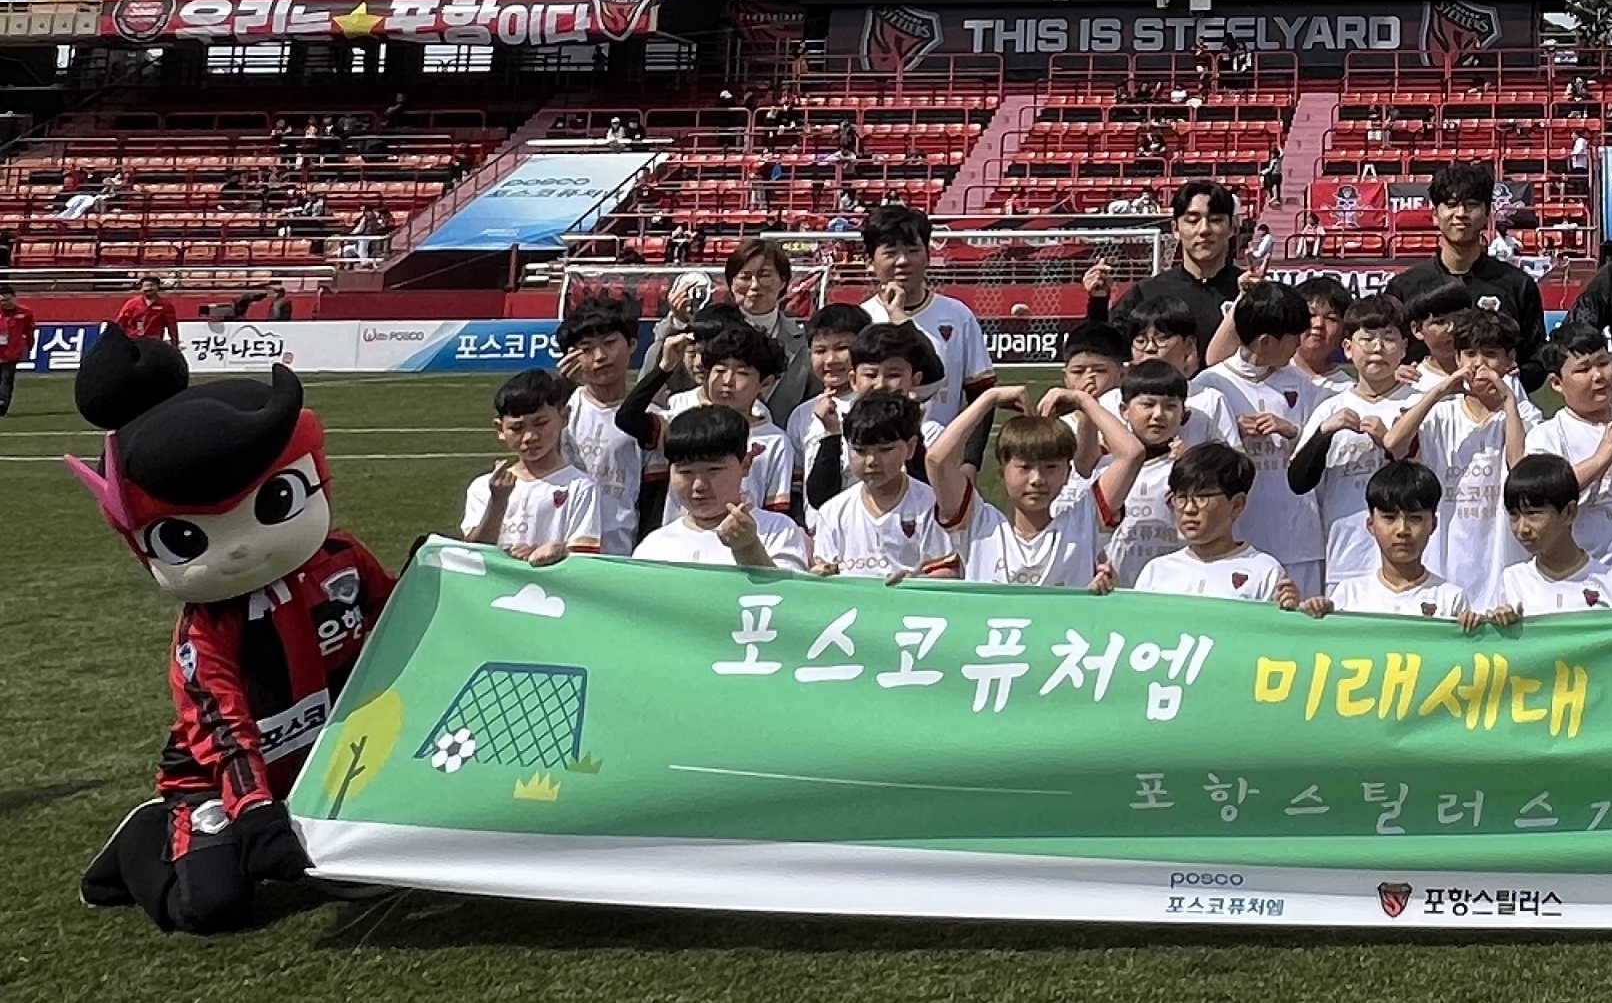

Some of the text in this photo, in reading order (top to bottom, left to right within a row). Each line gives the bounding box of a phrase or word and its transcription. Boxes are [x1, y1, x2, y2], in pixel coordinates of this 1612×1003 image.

[963, 15, 1401, 54] THIS IS STEELYARD
[982, 331, 1057, 362] upang
[711, 594, 1214, 721] 포스코퓨처엠
[1253, 652, 1588, 739] 미래세대
[260, 703, 326, 754] 포스코
[1170, 871, 1245, 889] posco
[1165, 896, 1285, 917] 포스코퓨처엠
[1423, 887, 1563, 917] 포항스틸러스
